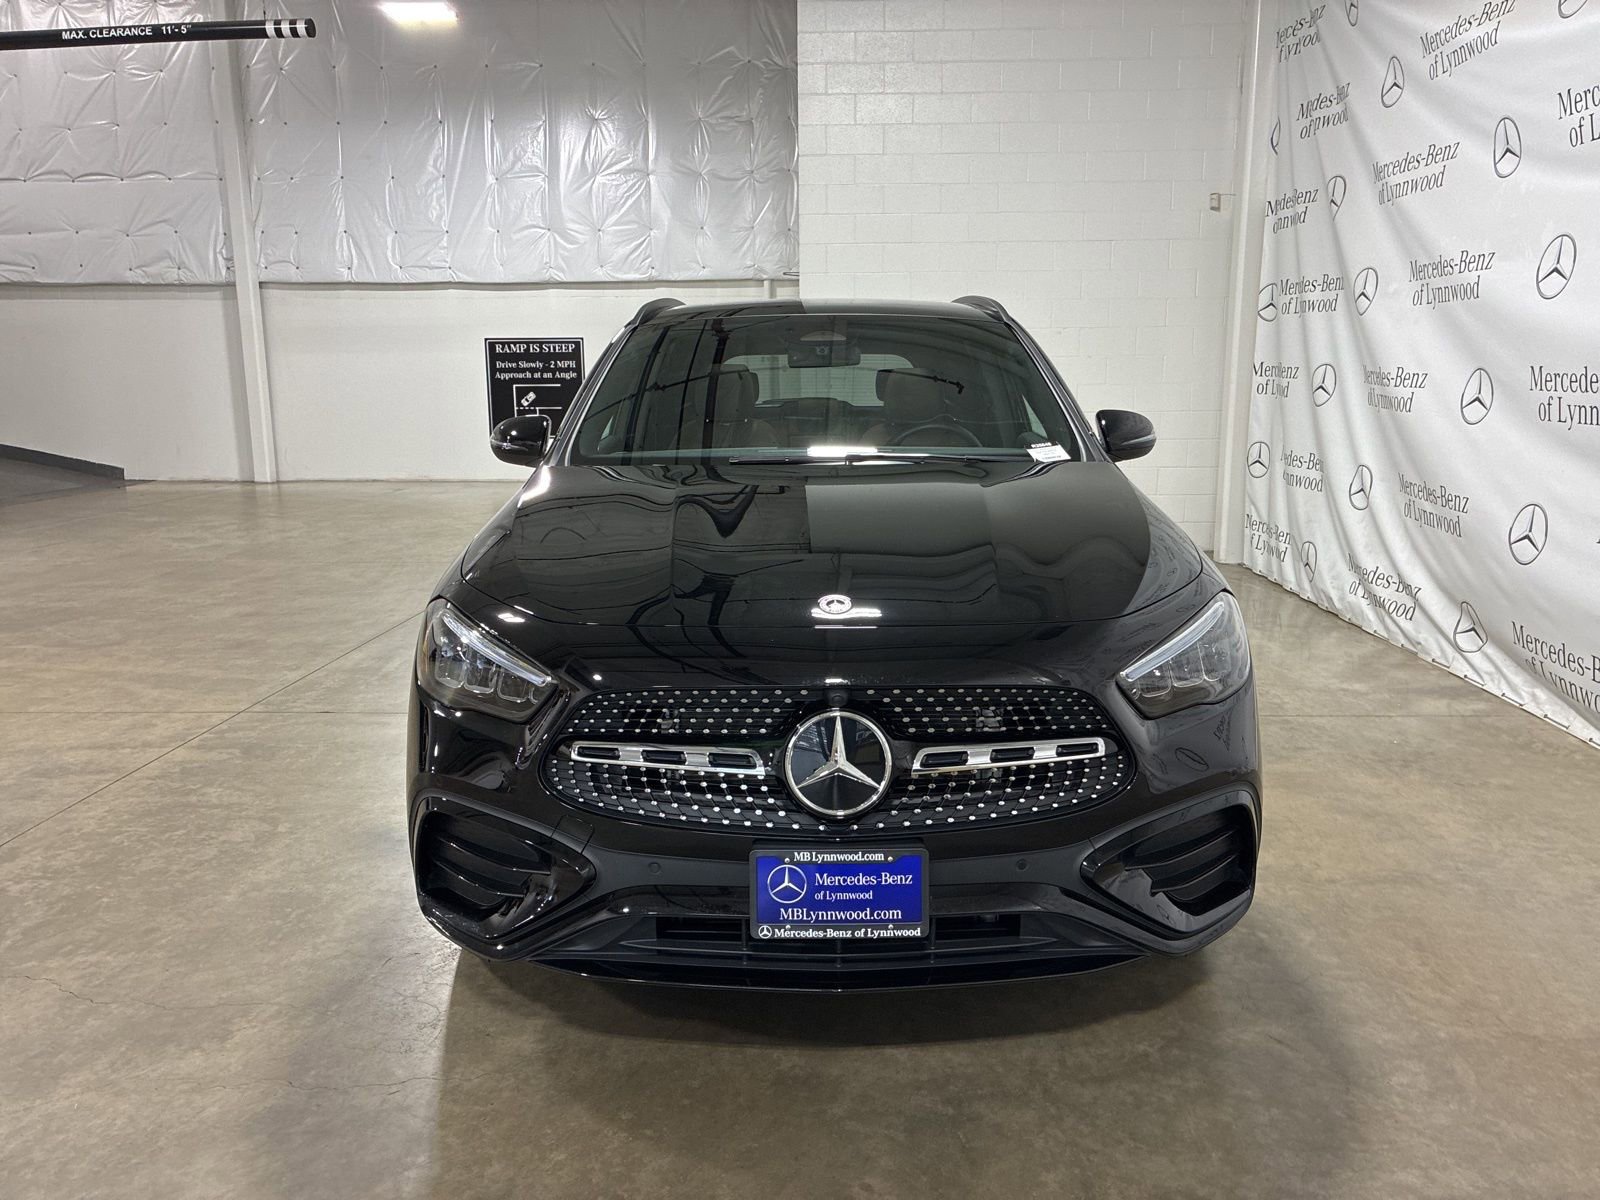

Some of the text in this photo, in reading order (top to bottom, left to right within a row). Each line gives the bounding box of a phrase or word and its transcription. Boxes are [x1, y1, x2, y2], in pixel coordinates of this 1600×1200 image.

[61, 30, 87, 40] MAX.
[89, 26, 153, 39] CLEARANCE
[1420, 0, 1516, 59] Mercedes-Benz
[1429, 19, 1501, 80] of Lynnwood
[1556, 84, 1600, 120] Merc
[1569, 112, 1600, 147] of L
[1372, 141, 1460, 185] Mercedes-Benz
[1378, 164, 1446, 207] of Lynnwood
[1409, 249, 1496, 282] Mercedes-Benz
[1281, 297, 1294, 315] of
[1412, 274, 1480, 310] of Lynnwood
[495, 343, 575, 353] RAMP IS STEEP
[495, 360, 517, 369] Drive
[519, 360, 544, 370] Slowly
[556, 360, 576, 368] MPH
[495, 371, 532, 380] Approach
[533, 371, 541, 379] at
[554, 370, 578, 380] Angle
[1529, 365, 1599, 394] Mercede
[1256, 378, 1270, 395] of
[1538, 395, 1600, 431] of Lynn
[1398, 471, 1470, 514] Mercedes-Benz
[1403, 498, 1463, 538] of Lynnwood
[815, 872, 913, 886] Mercedes-Benz
[814, 890, 873, 902] of Lynnwood
[779, 907, 902, 923] MBLynnwood.com
[774, 927, 921, 939] Mercedes-Benz of Lynnwood
